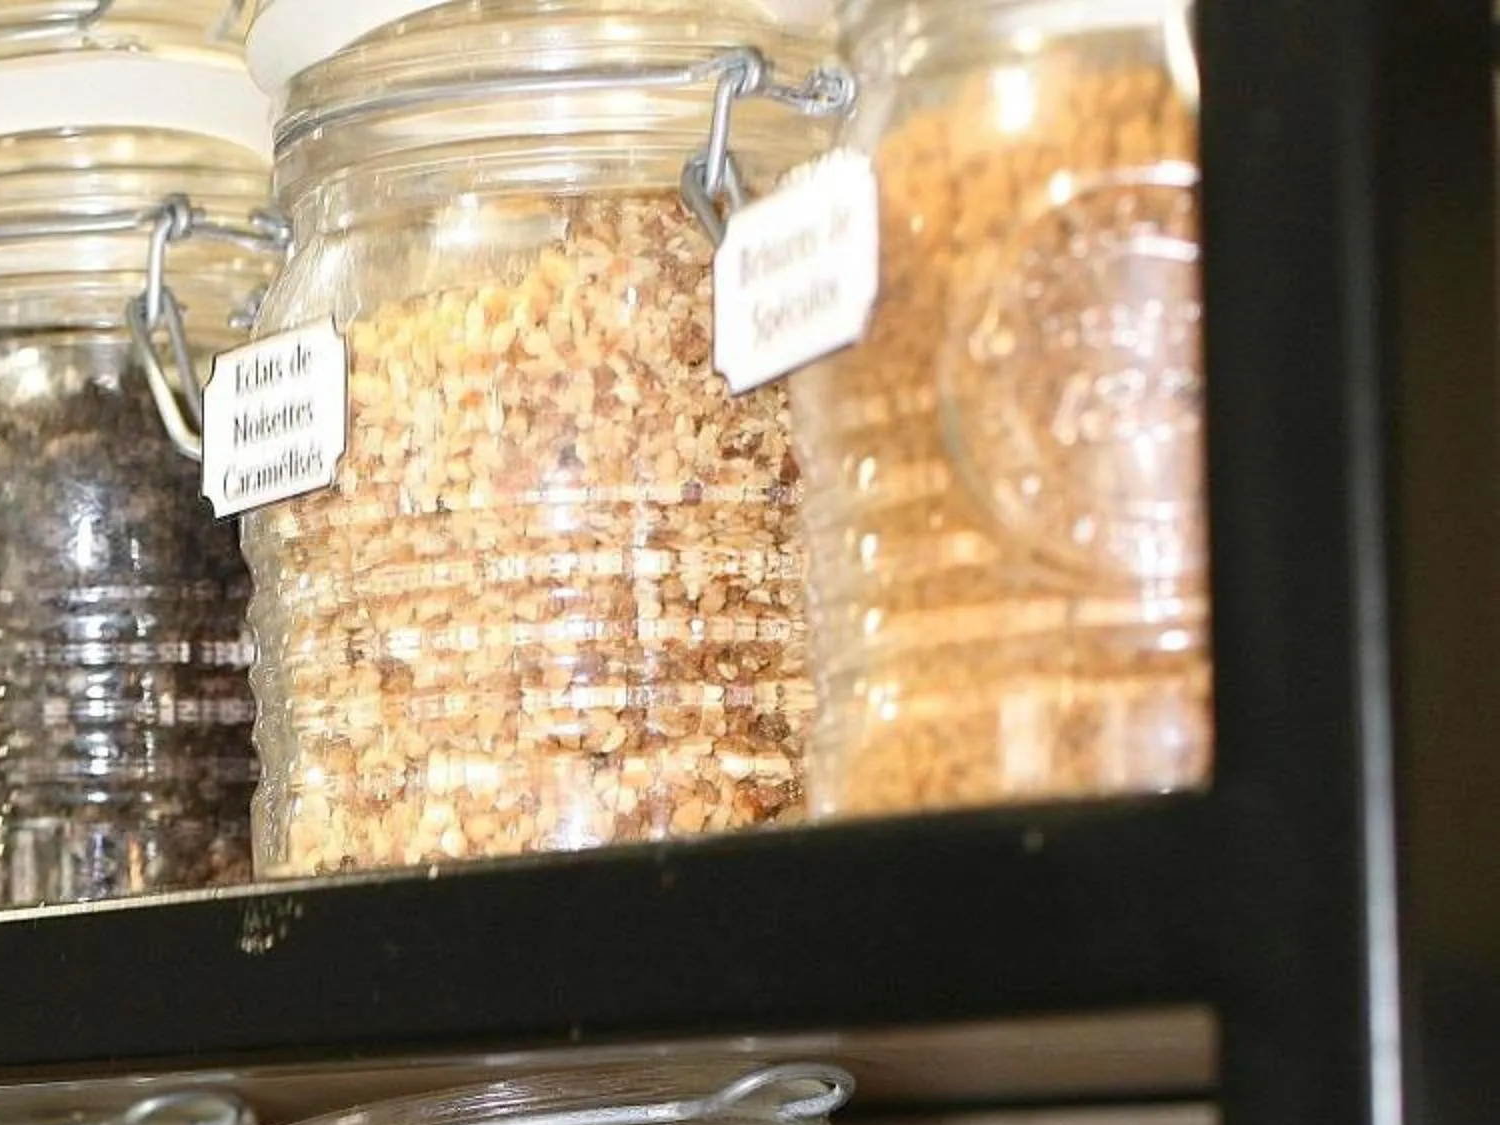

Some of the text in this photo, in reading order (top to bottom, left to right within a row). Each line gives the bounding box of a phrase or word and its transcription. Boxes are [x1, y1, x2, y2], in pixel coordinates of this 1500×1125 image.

[289, 343, 312, 376] de
[233, 400, 314, 447] Noisettes
[223, 441, 324, 499] Caramélisés
